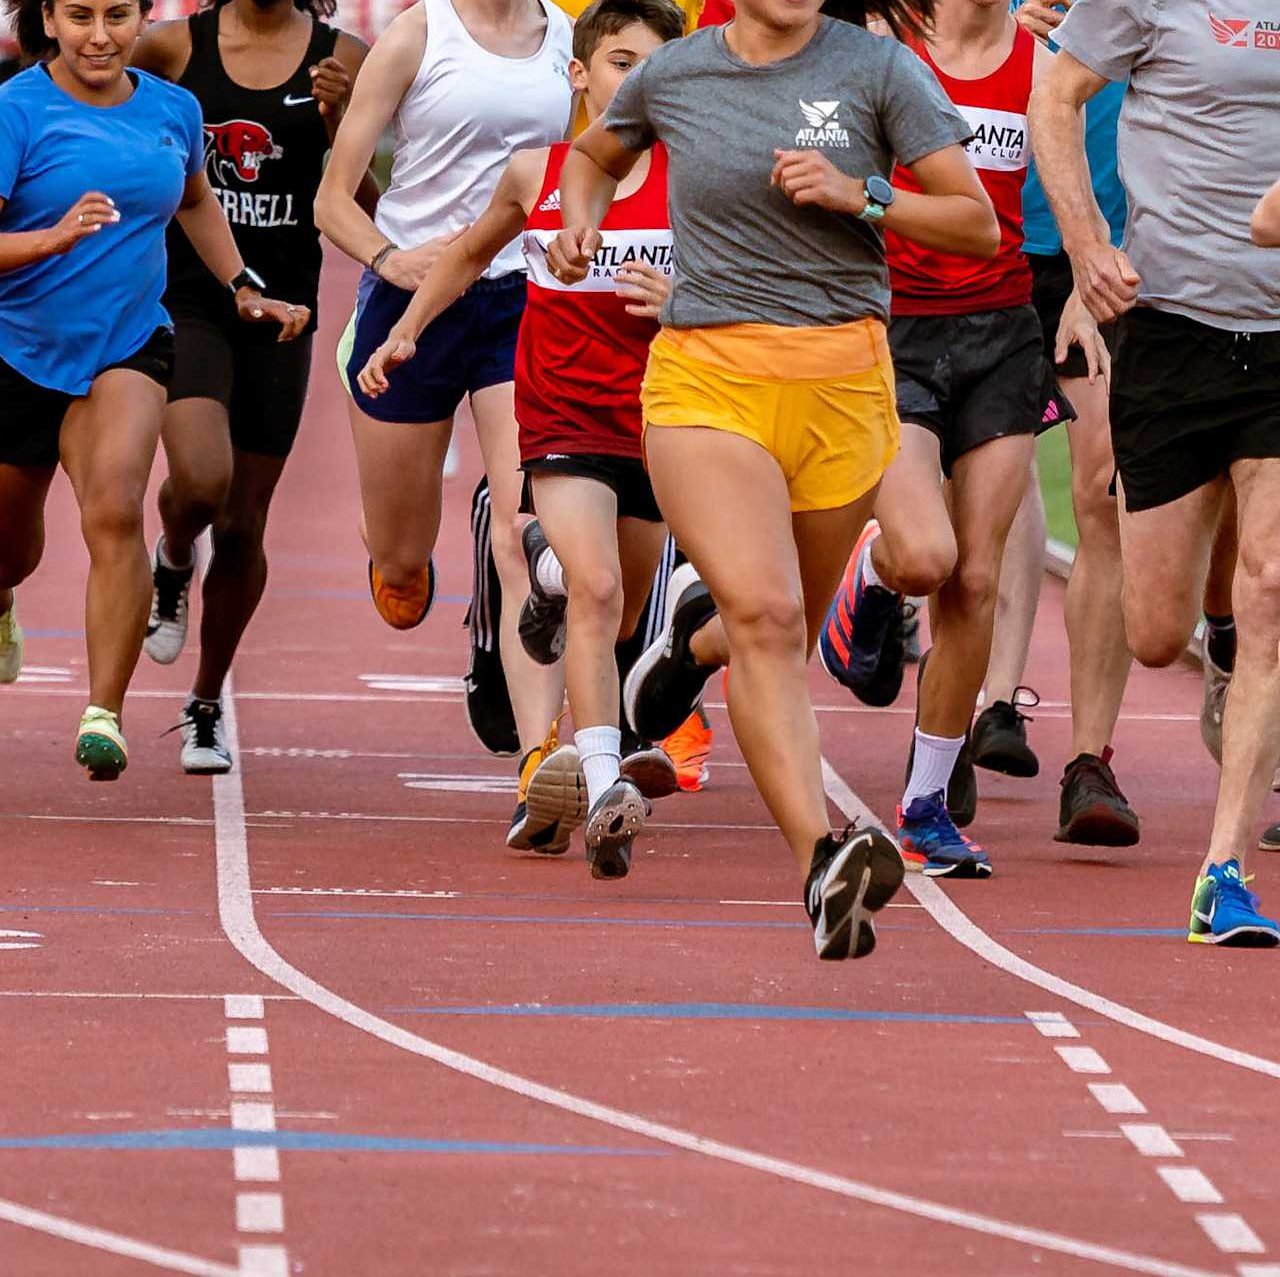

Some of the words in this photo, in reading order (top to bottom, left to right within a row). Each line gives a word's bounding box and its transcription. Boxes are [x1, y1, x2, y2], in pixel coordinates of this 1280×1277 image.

[795, 129, 849, 142] ATLANTA
[974, 123, 1024, 150] ANTA
[991, 147, 1022, 159] CLUB
[212, 187, 298, 227] RRELL
